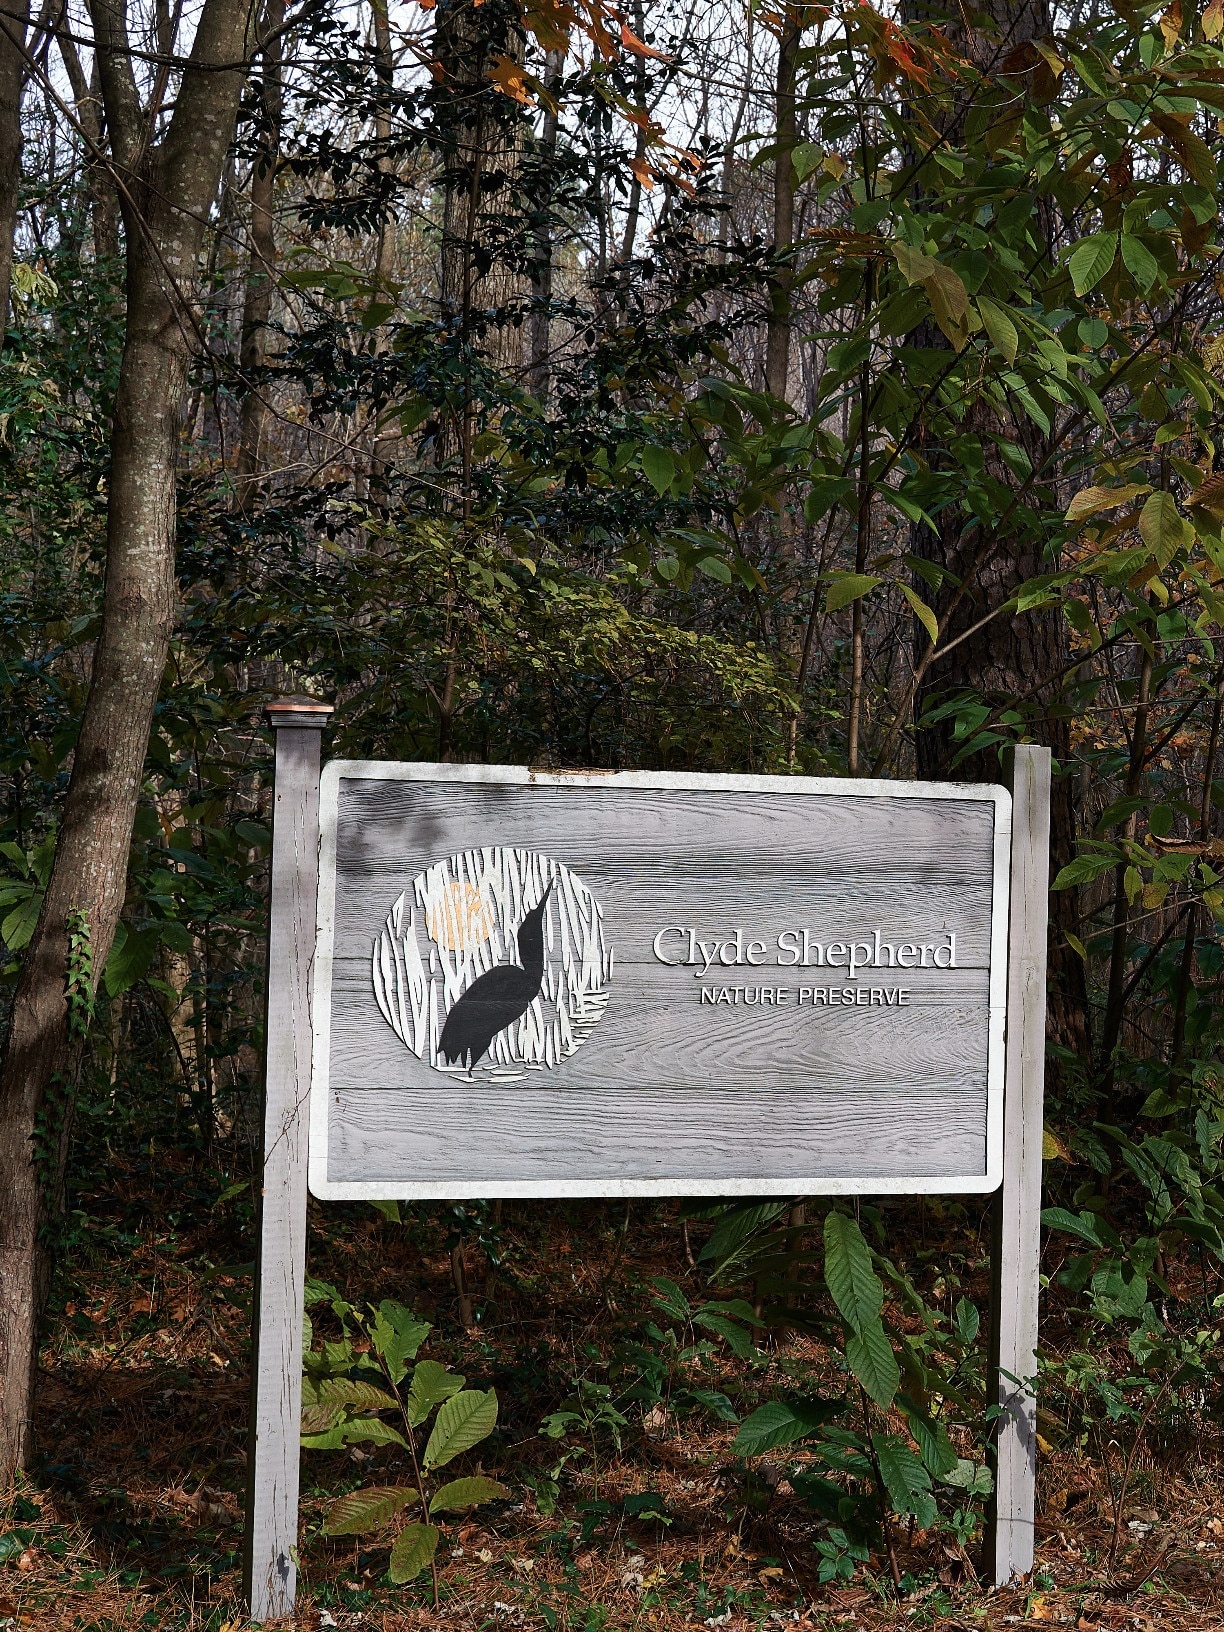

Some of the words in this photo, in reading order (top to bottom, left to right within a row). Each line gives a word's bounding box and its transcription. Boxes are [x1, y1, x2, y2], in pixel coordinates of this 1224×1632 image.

[652, 926, 767, 978] Clyde
[776, 928, 959, 979] Shepherd
[700, 986, 789, 1006] NATURE
[799, 987, 911, 1007] PRESERVE
